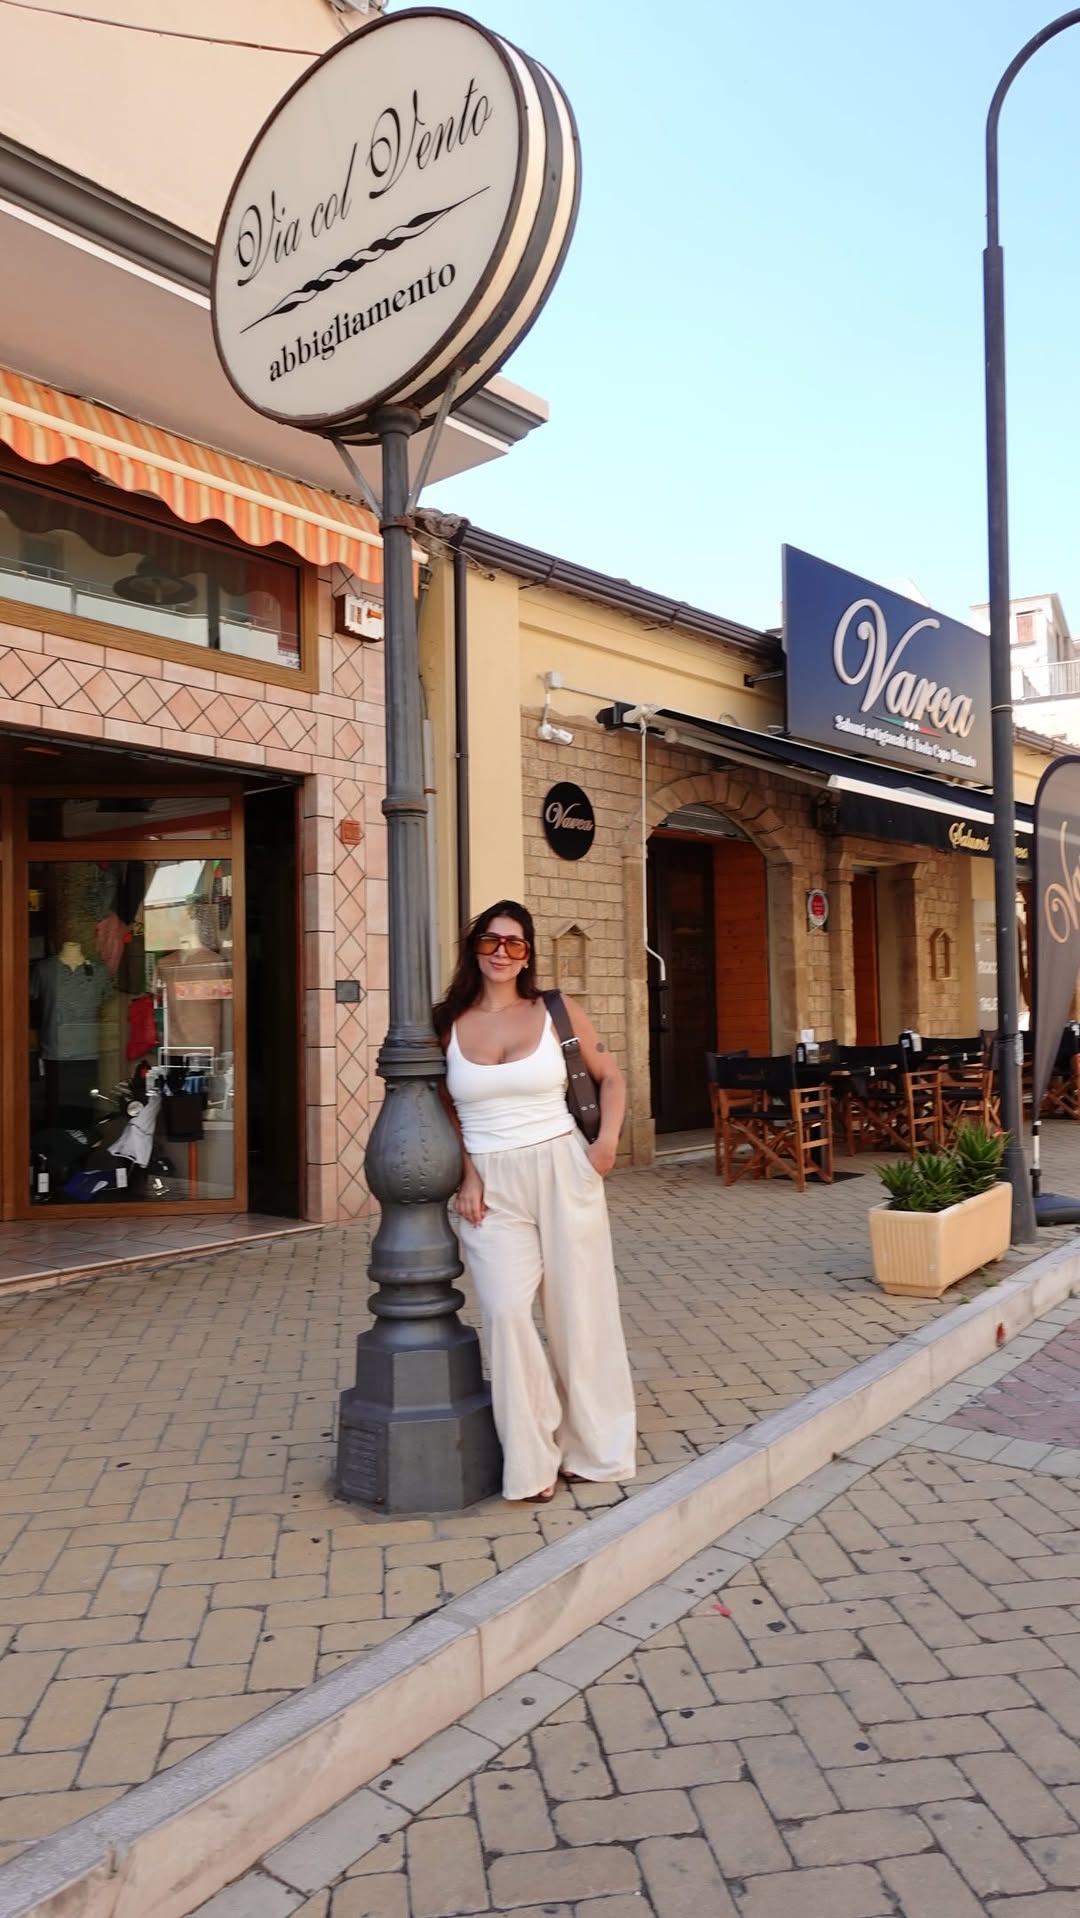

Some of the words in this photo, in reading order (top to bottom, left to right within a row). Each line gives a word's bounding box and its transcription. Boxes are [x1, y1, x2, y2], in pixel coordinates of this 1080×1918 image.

[236, 189, 302, 286] Via
[310, 142, 358, 238] col
[366, 78, 493, 200] Vento
[269, 263, 456, 382] abbigliamento
